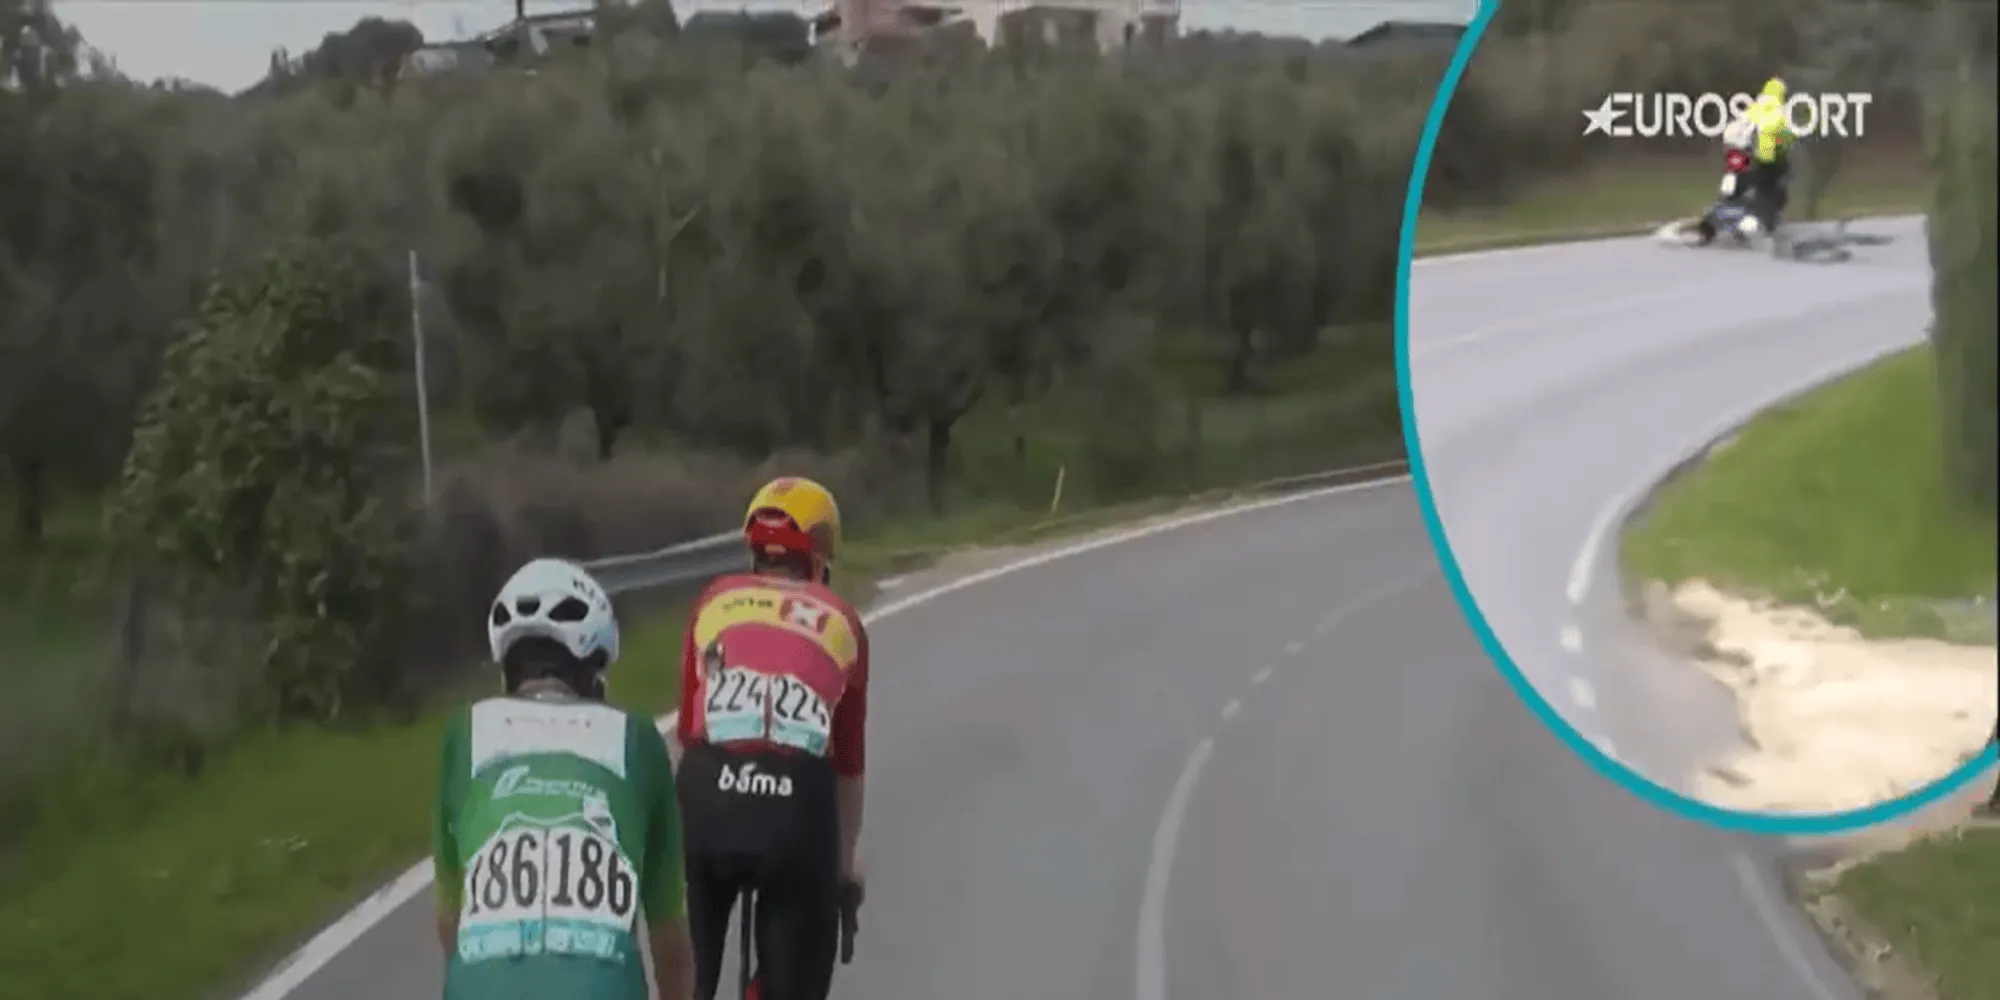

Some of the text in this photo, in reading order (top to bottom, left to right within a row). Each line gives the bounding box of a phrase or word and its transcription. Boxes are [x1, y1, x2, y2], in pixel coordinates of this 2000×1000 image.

[706, 671, 763, 713] 224
[469, 832, 633, 917] 186 186
